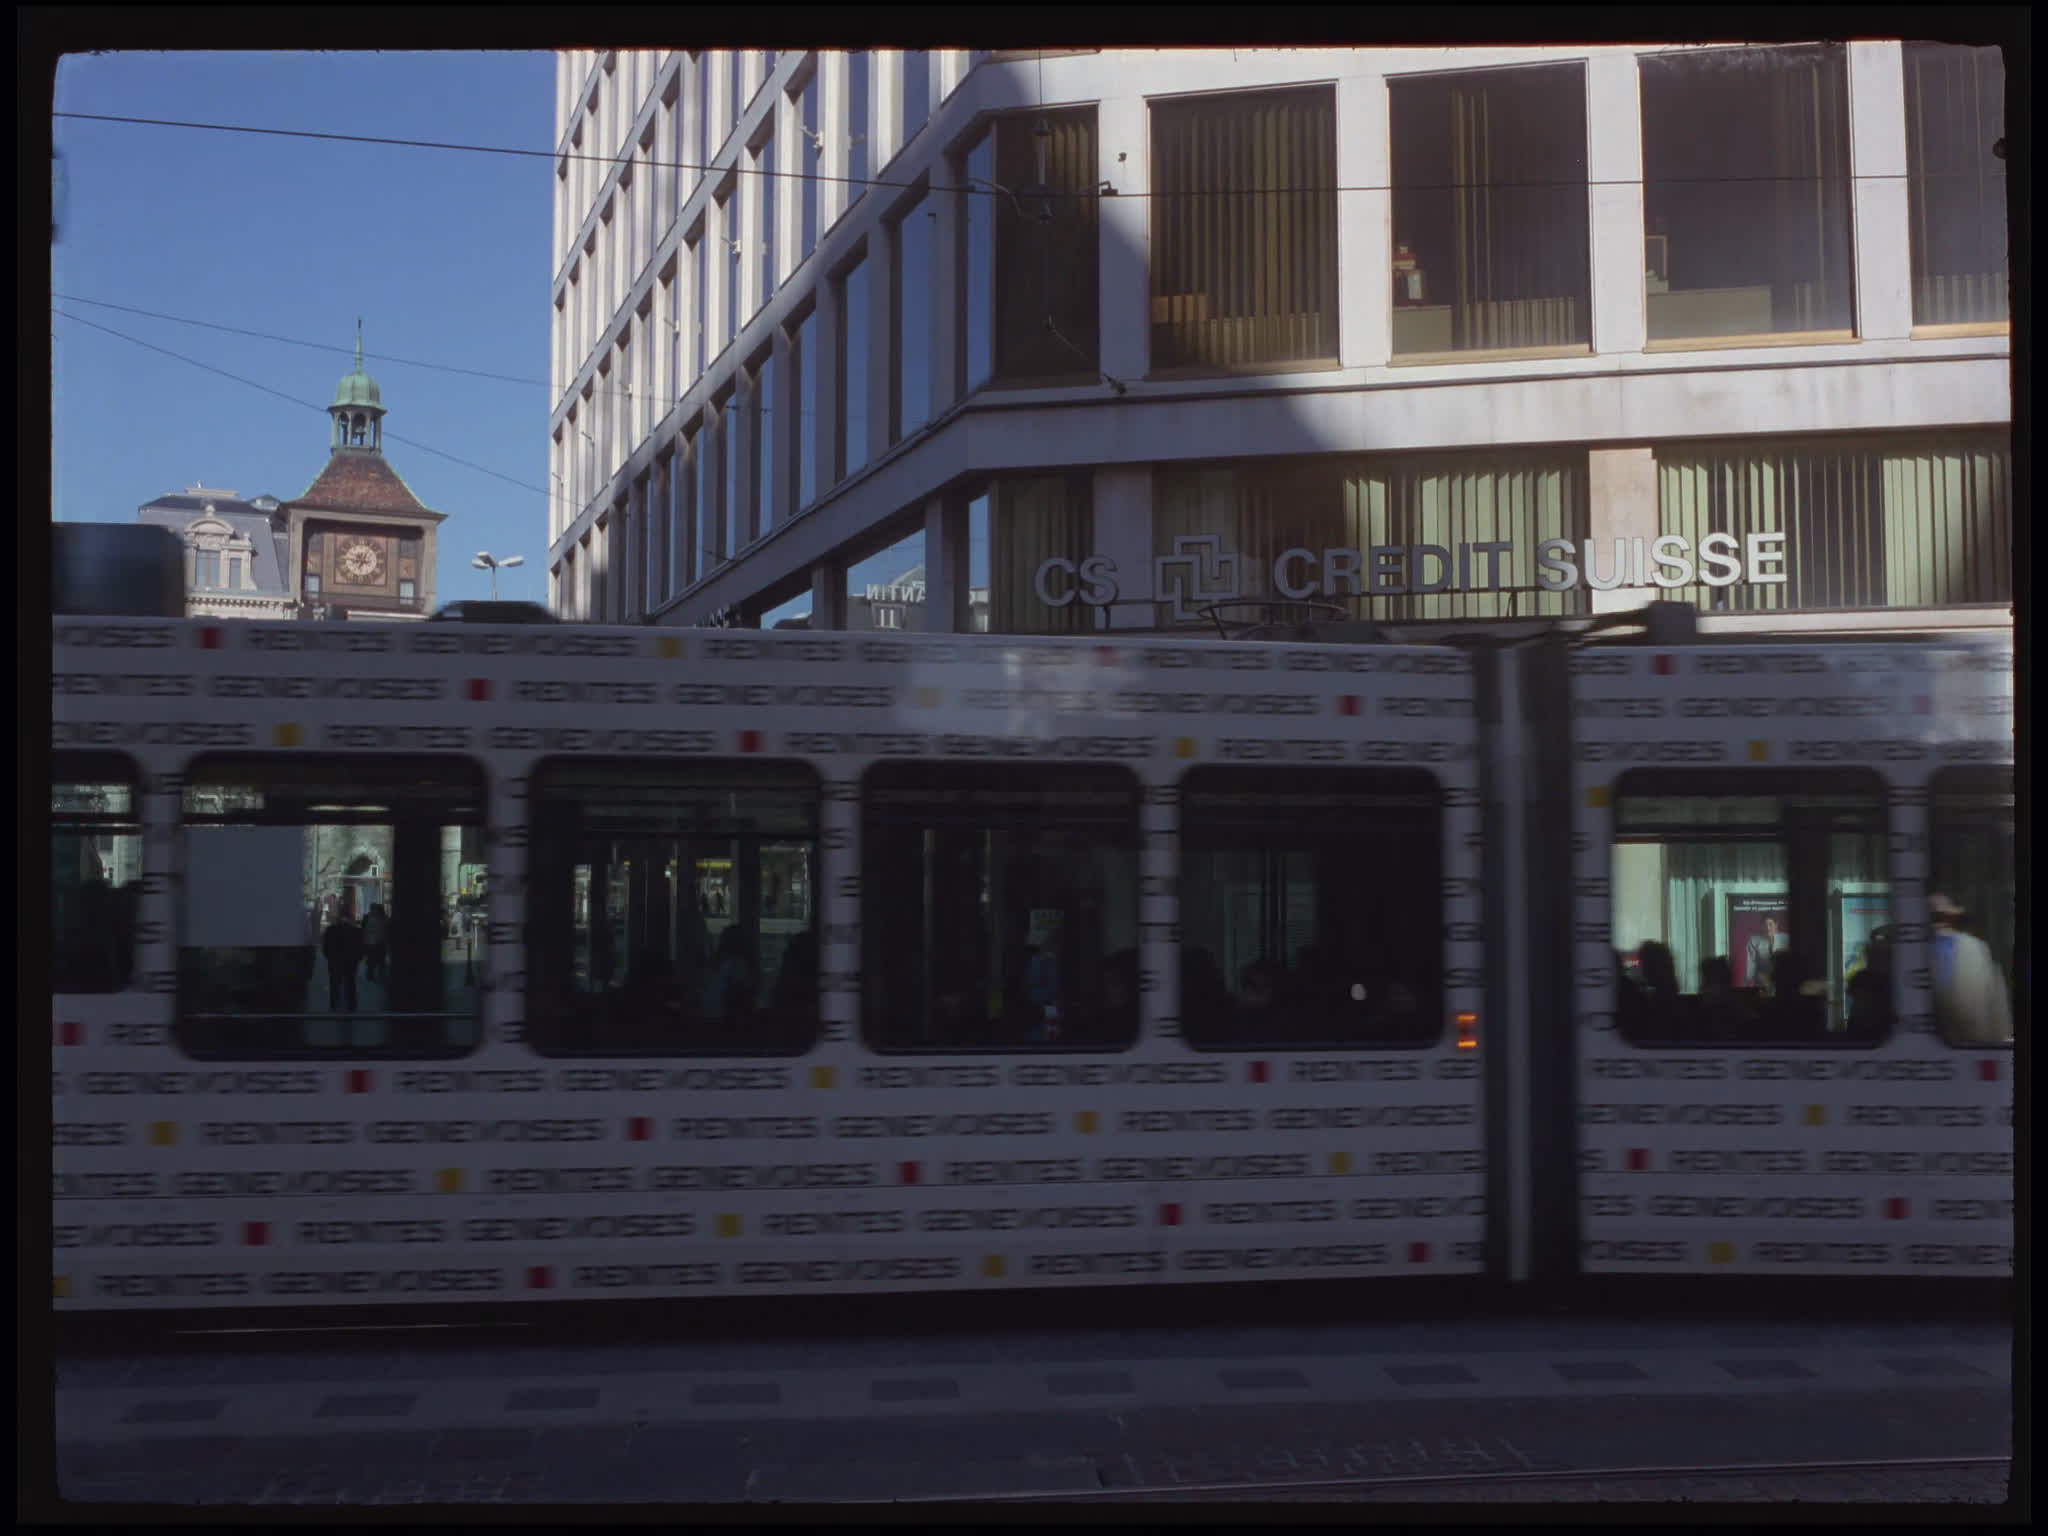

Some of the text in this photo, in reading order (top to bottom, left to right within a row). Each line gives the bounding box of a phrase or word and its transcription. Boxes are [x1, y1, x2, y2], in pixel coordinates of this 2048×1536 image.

[1035, 532, 1787, 605] CS CREDIT SUISSE
